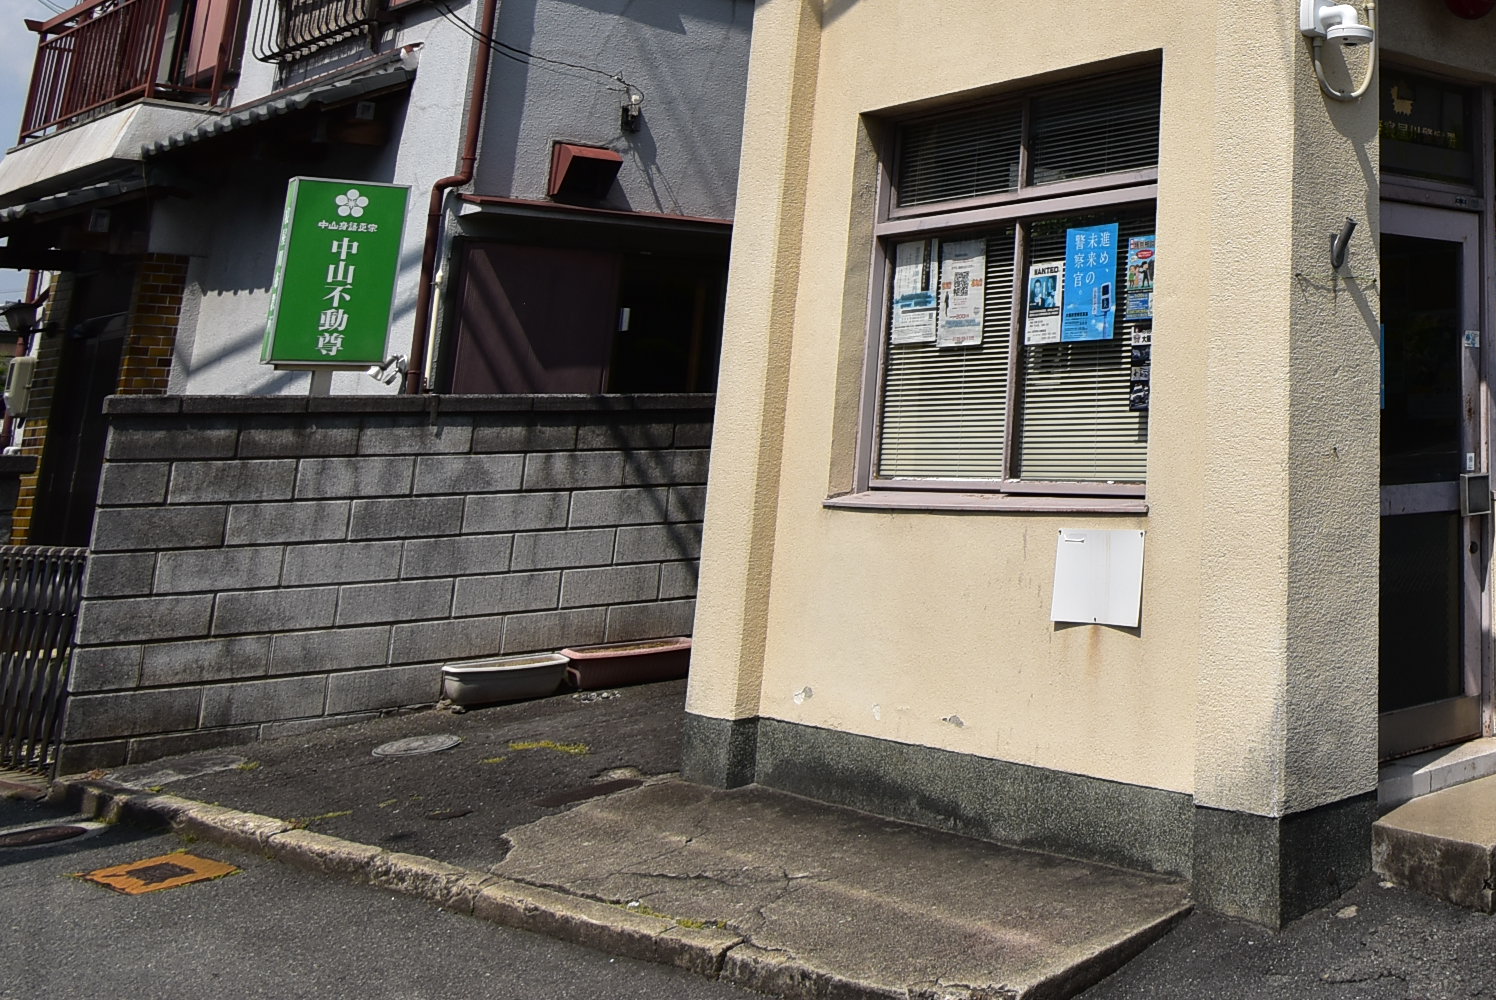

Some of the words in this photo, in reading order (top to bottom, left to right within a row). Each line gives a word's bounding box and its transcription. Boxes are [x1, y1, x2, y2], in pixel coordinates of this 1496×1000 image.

[317, 219, 378, 232] 中山身語正宗
[1034, 266, 1059, 276] WANTED
[1085, 232, 1098, 285] 未来の
[314, 237, 360, 356] 中山不動尊
